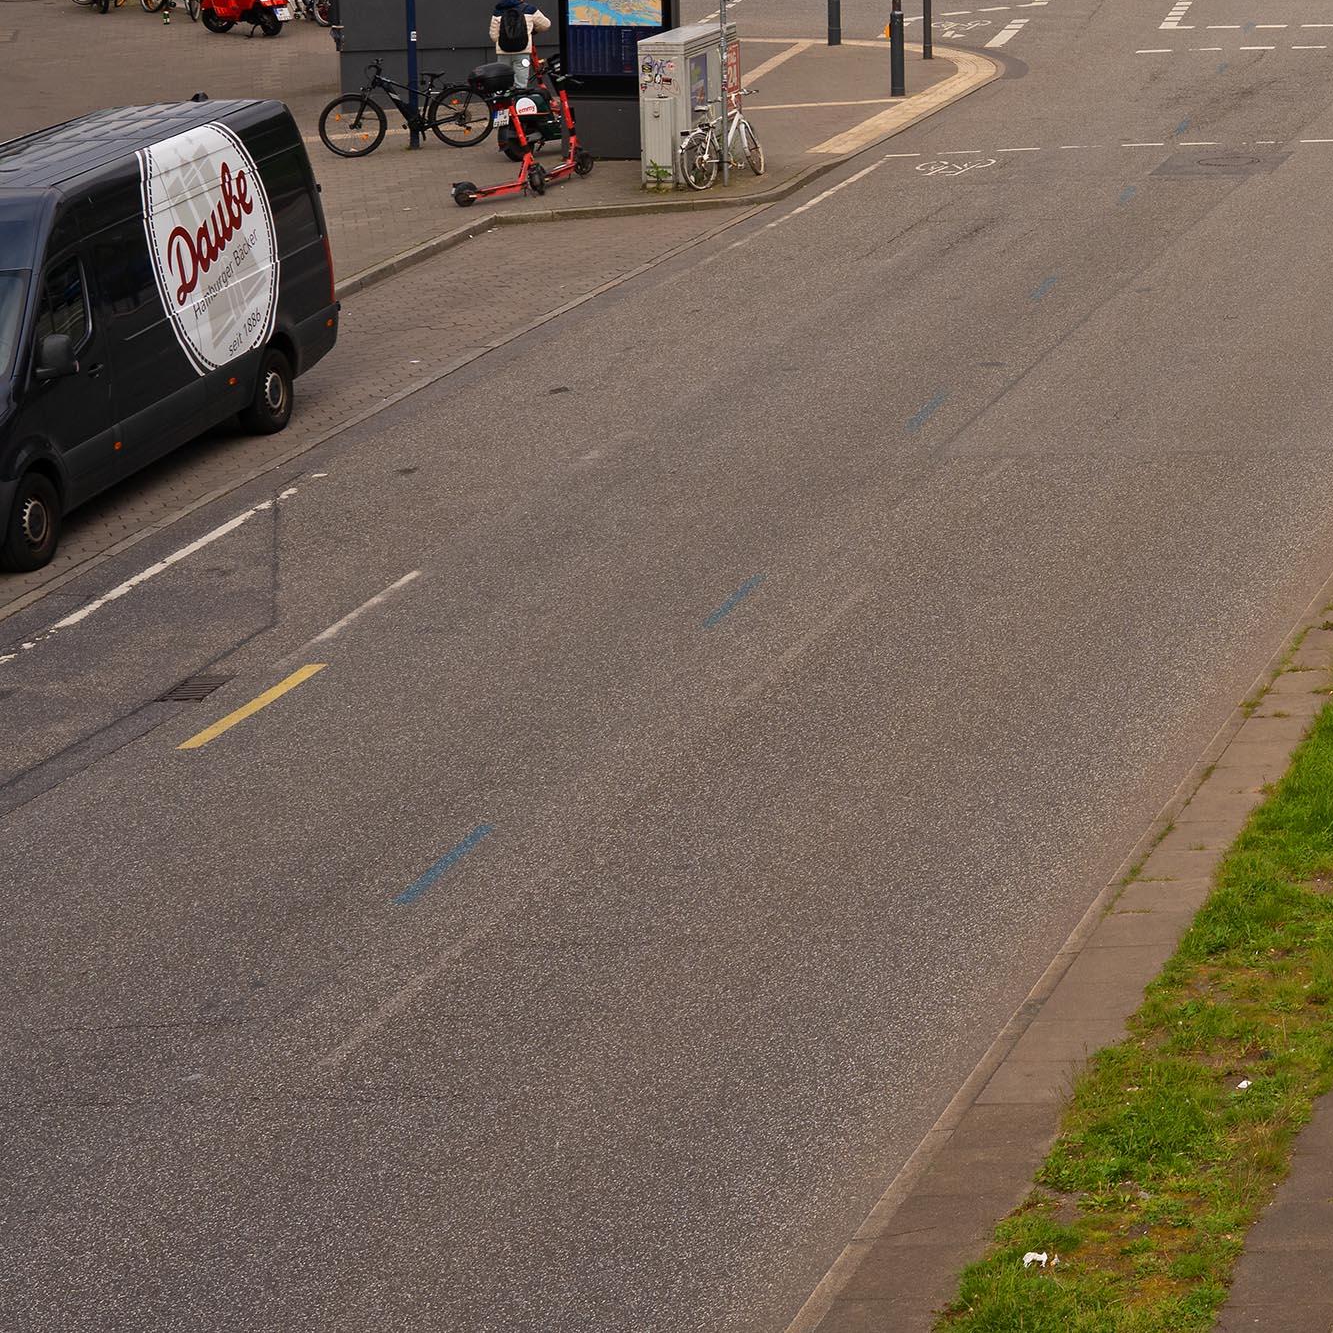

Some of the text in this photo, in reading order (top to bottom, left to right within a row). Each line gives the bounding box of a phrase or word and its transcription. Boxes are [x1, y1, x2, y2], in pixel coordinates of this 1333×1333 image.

[518, 106, 536, 114] emmy
[167, 161, 255, 307] Daube
[192, 227, 259, 321] Hamburger Bäcker
[227, 310, 262, 358] seit 1886
